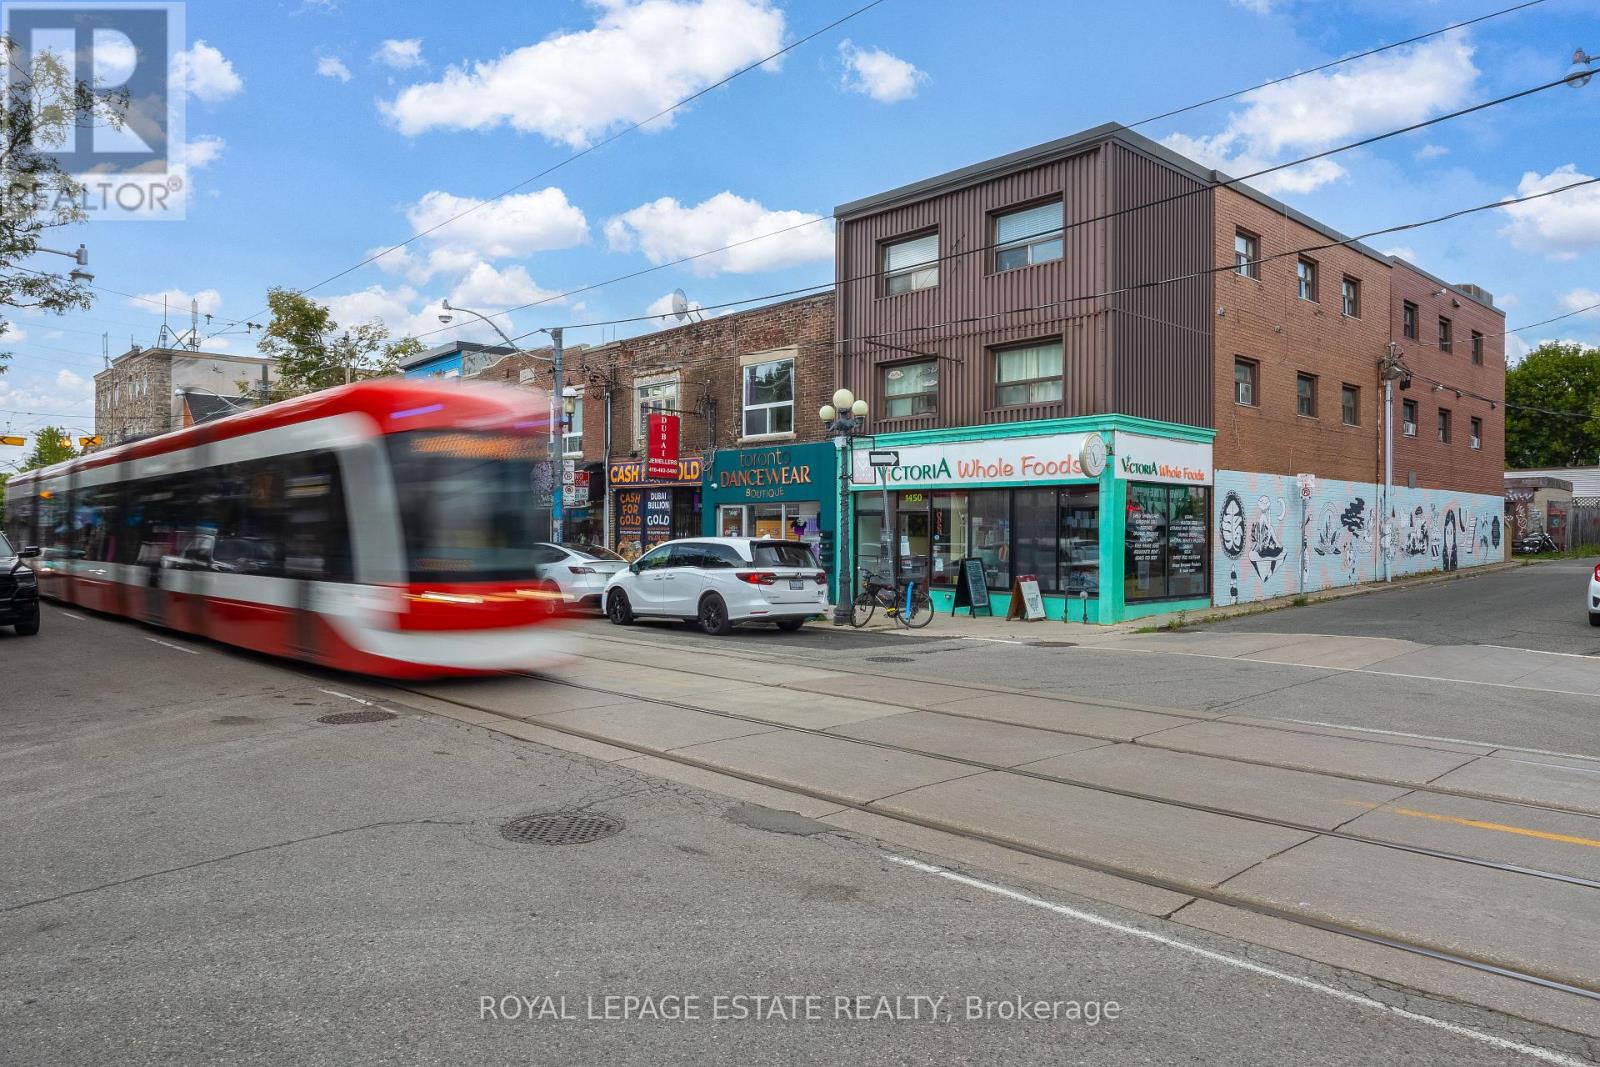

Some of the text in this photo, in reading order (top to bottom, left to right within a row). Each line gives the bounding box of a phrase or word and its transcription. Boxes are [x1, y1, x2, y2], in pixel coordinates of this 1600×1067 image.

[648, 457, 678, 466] JEWELLERS
[740, 448, 792, 467] toronto
[610, 464, 639, 483] CASH
[678, 461, 700, 481] OLD
[957, 456, 1014, 479] Whole
[1021, 453, 1085, 476] Foods
[1159, 463, 1182, 479] Whole
[1183, 466, 1205, 481] Foods
[720, 465, 812, 488] DANCEWEAR
[620, 492, 641, 504] CASH
[650, 491, 667, 501] DUBAI
[745, 486, 785, 498] BOUTIQUE
[905, 493, 923, 503] 1450
[622, 504, 639, 515] FOR
[647, 501, 671, 510] BULLION
[620, 515, 641, 526] GOLD
[647, 514, 670, 526] GOLD
